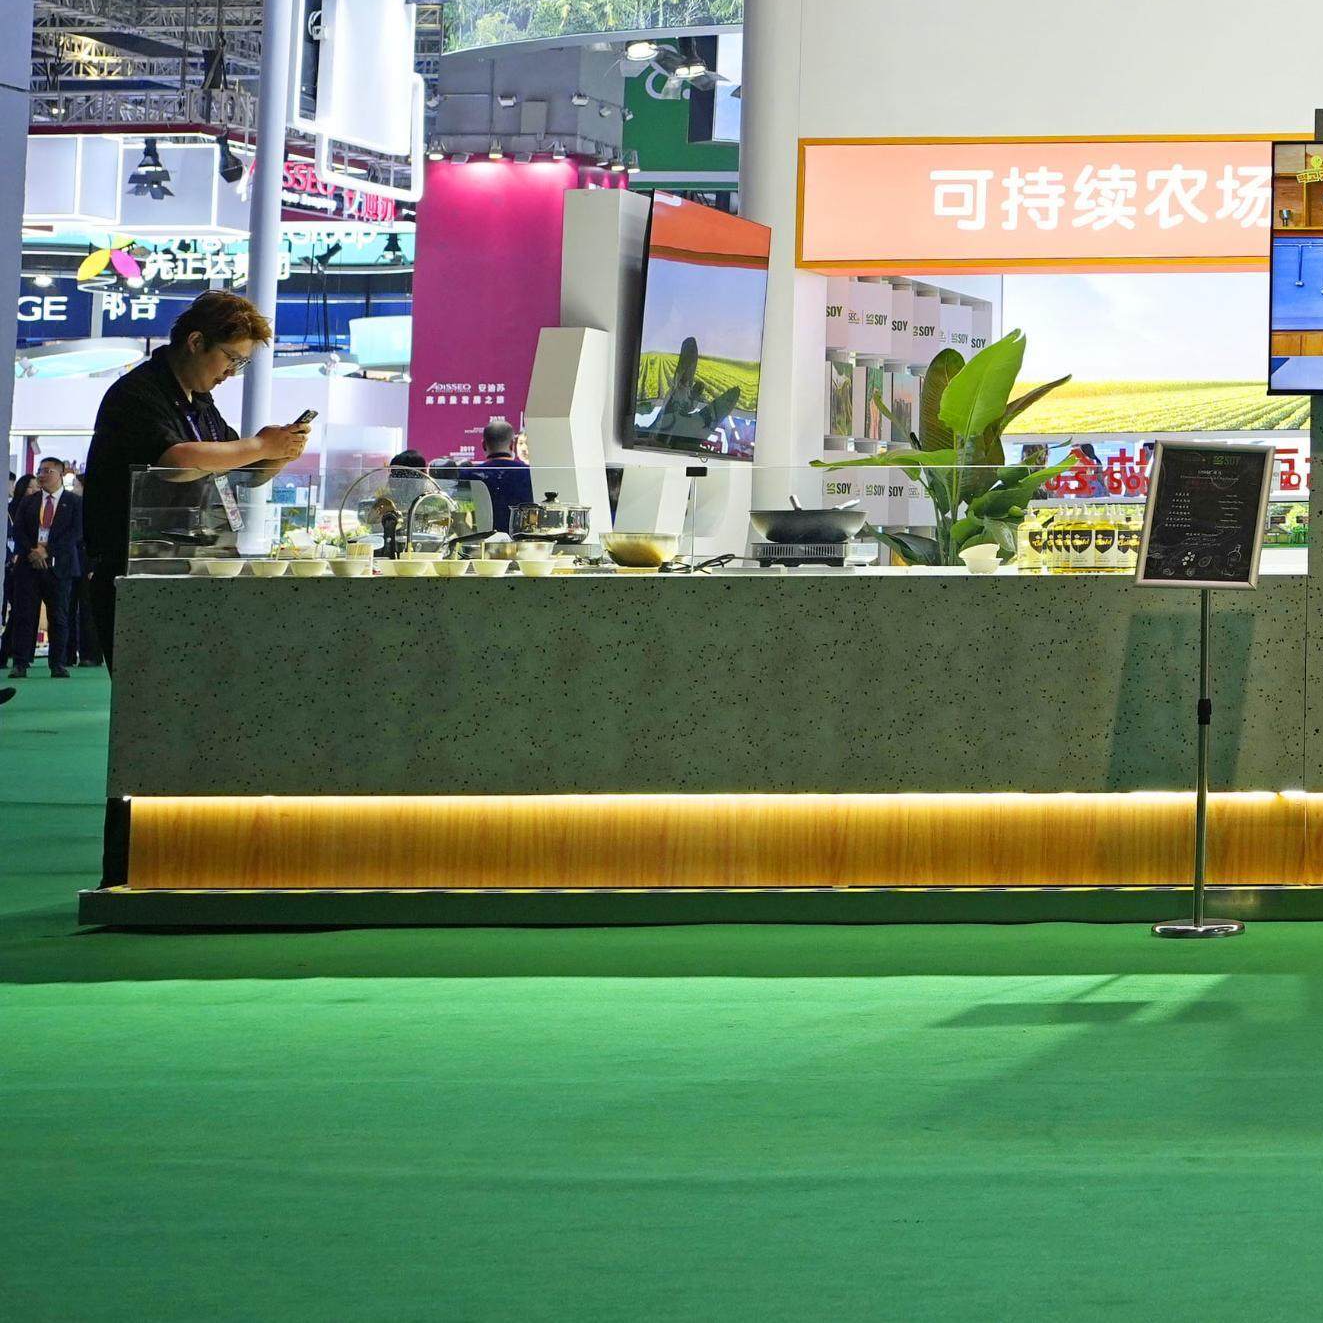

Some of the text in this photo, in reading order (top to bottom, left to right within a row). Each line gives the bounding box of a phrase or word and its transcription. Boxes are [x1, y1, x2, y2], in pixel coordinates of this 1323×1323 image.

[927, 166, 1271, 233] 可持续农场
[874, 314, 888, 326] SOY
[891, 320, 908, 332] SOY
[918, 325, 935, 337] SOY
[970, 338, 987, 349] SOY
[836, 482, 852, 496] SOY
[874, 484, 886, 497] SOY
[888, 485, 904, 497] SOY
